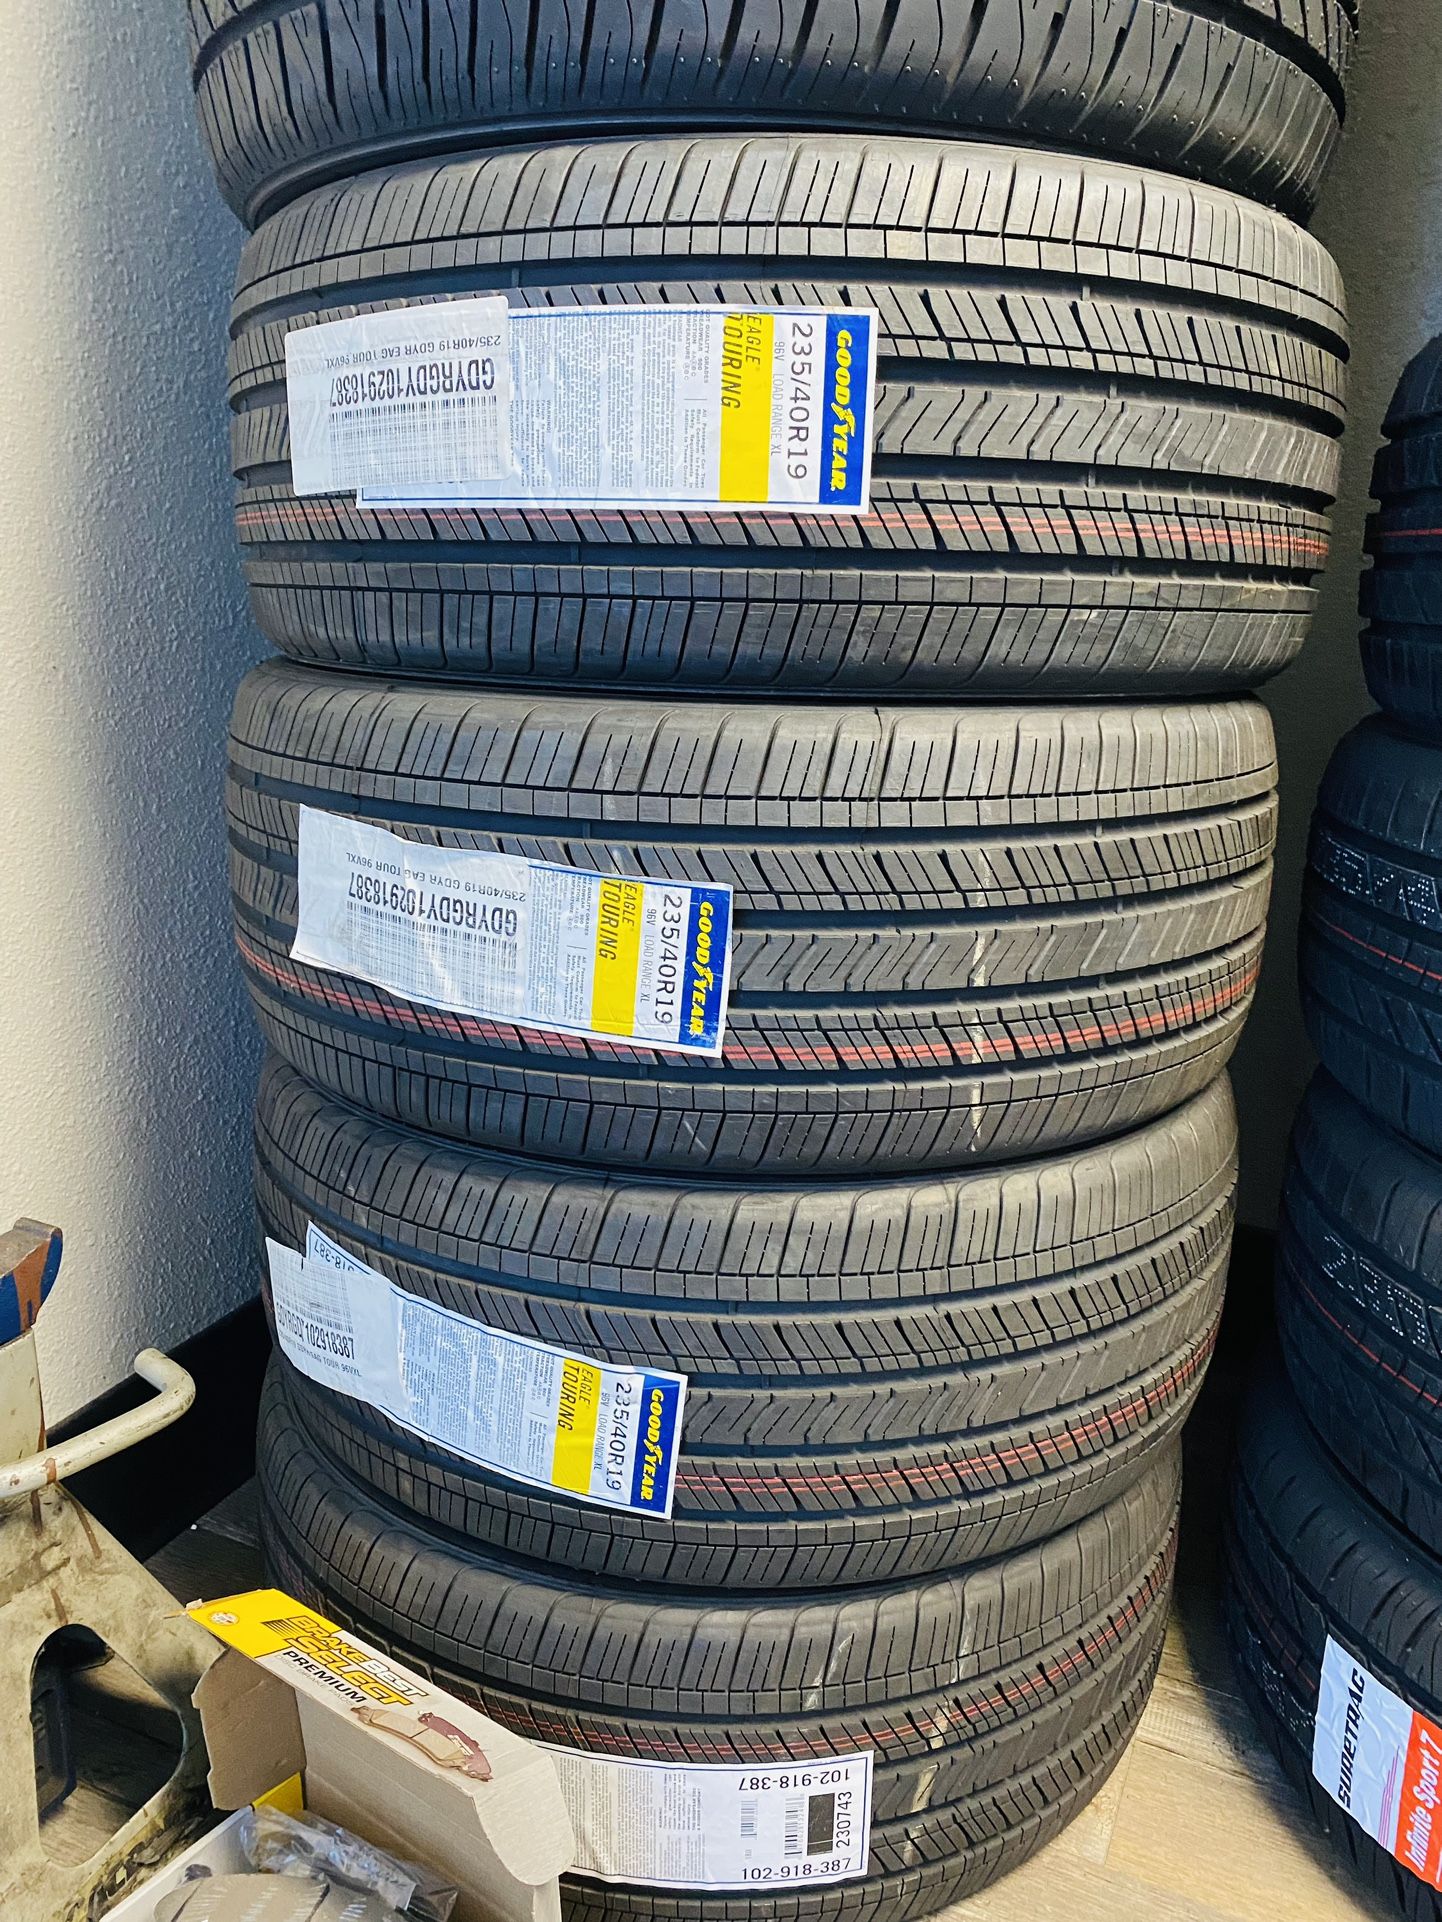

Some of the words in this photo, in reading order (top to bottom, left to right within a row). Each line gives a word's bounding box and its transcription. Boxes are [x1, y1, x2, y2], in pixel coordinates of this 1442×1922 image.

[382, 347, 400, 359] EAG
[405, 342, 435, 355] GDYR
[439, 335, 501, 351] 235/40R19
[745, 315, 762, 365] EAGLE
[773, 341, 784, 361] 96V
[720, 313, 743, 409] TOURING
[772, 373, 783, 400] LOAD
[786, 322, 813, 480] 235/40R19
[770, 404, 782, 439] RANGE
[828, 329, 857, 492] GOODYEAR
[770, 443, 781, 456] XL
[346, 852, 373, 867] 96VXL
[376, 861, 400, 875] TOUR
[404, 869, 425, 882] EAG
[429, 876, 461, 889] GDYR
[465, 881, 526, 902] 235/40R19
[349, 872, 518, 936] GDYRGDY102918387
[598, 880, 621, 960] TOURING
[621, 883, 637, 926] EAGLE
[645, 908, 656, 925] 96V
[643, 934, 654, 957] LOAD
[653, 894, 682, 1024] 235/40R19
[640, 959, 652, 989] RANGE
[686, 901, 718, 1038] GOODYEAR
[639, 992, 650, 1003] XL
[557, 1362, 579, 1431] TOURING
[578, 1368, 593, 1405] EAGLE
[604, 1381, 632, 1490] 235/40R19
[638, 1388, 668, 1503] GOODYEAR
[593, 1461, 602, 1470] XL
[283, 1650, 367, 1703] PREMIUM
[284, 1636, 414, 1705] SELECT
[738, 1768, 850, 1790] 102-918-387
[1412, 1748, 1441, 1809] Sport
[836, 1790, 852, 1847] 230743
[1405, 1808, 1433, 1872] Infinite
[741, 1857, 851, 1880] 102-918-387
